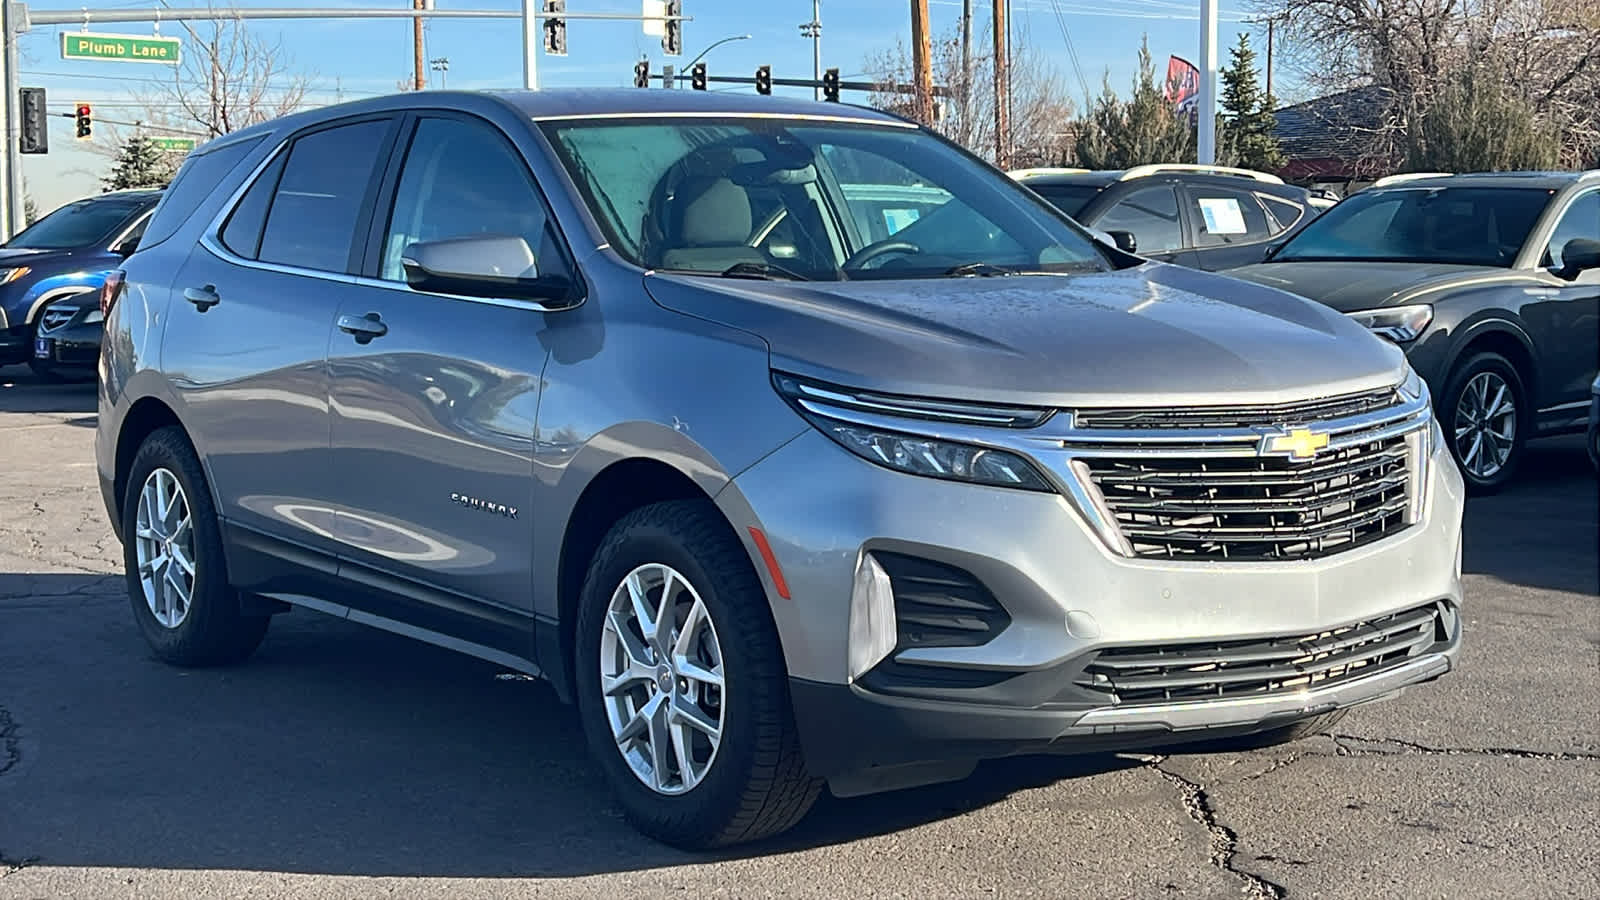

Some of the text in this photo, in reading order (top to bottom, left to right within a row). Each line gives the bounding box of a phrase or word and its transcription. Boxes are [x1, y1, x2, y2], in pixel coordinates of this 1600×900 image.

[79, 40, 167, 56] Plumb Lane
[450, 493, 518, 519] EQUINOX
